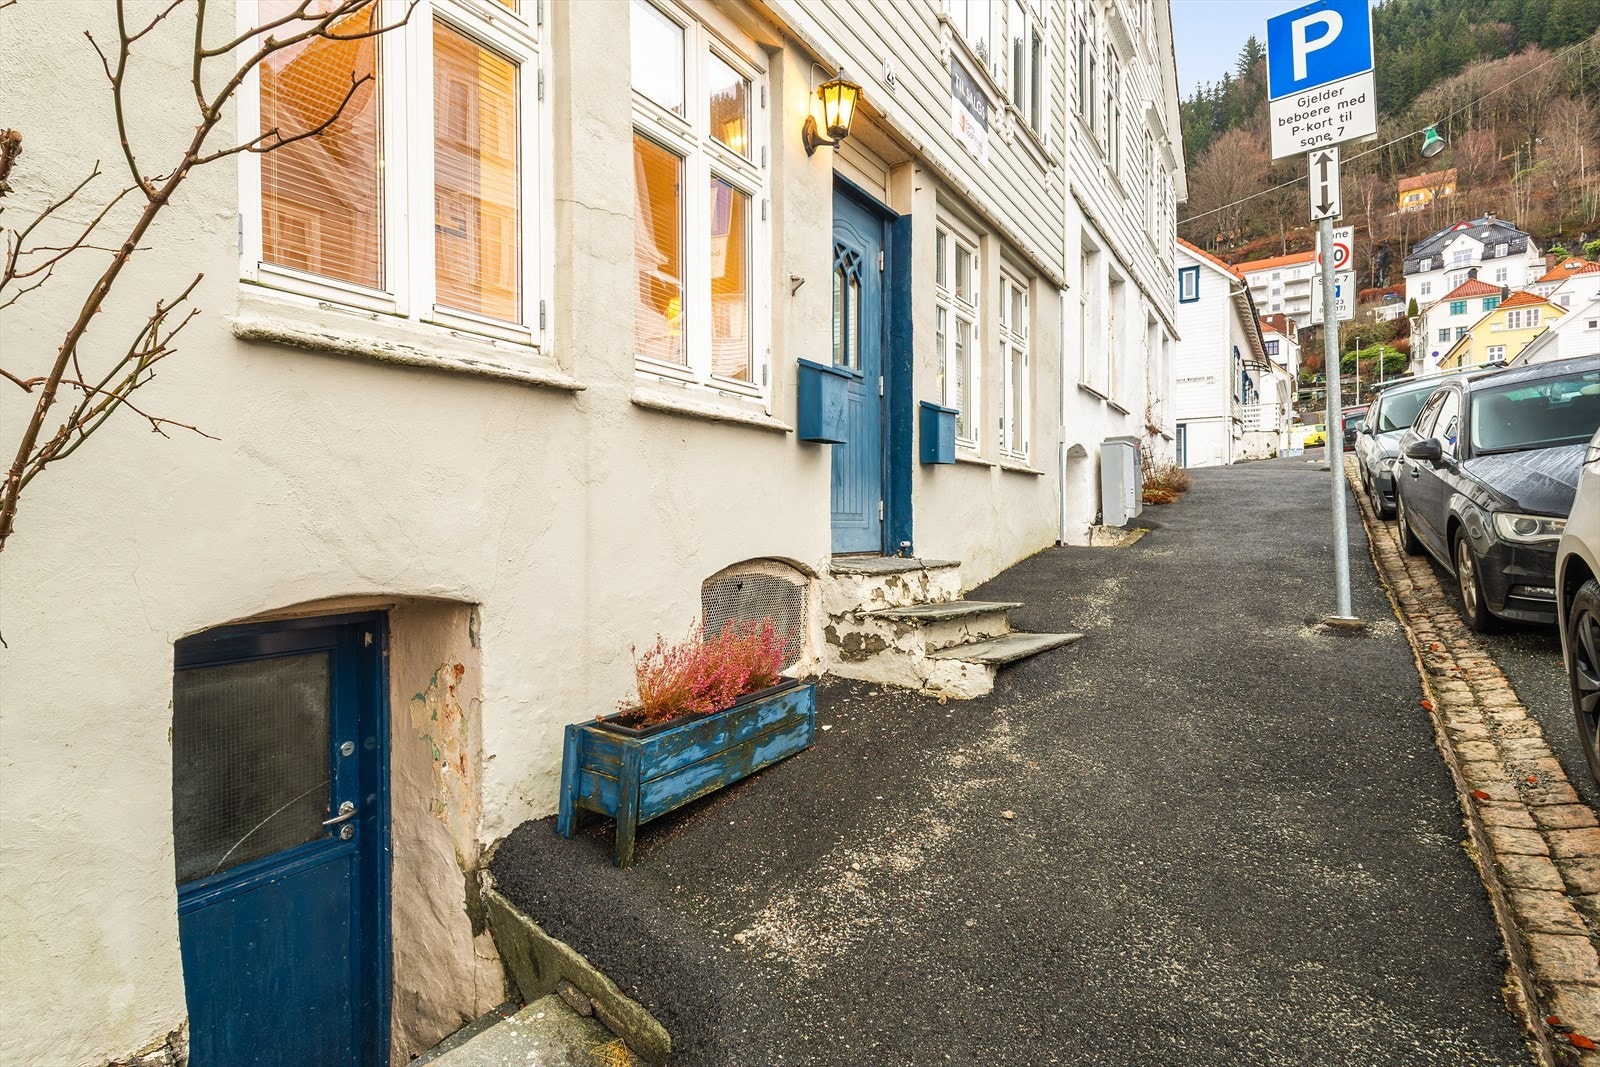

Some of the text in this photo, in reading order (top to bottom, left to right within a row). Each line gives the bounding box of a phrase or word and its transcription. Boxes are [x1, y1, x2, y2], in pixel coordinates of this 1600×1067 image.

[1291, 9, 1344, 82] P
[954, 73, 966, 97] TIL
[1297, 87, 1345, 108] Gjelder
[1278, 93, 1366, 127] beboere med
[1292, 111, 1353, 136] P-kort til
[1300, 126, 1345, 147] sone 7
[1333, 249, 1344, 262] 0
[1318, 275, 1349, 286] Se 7
